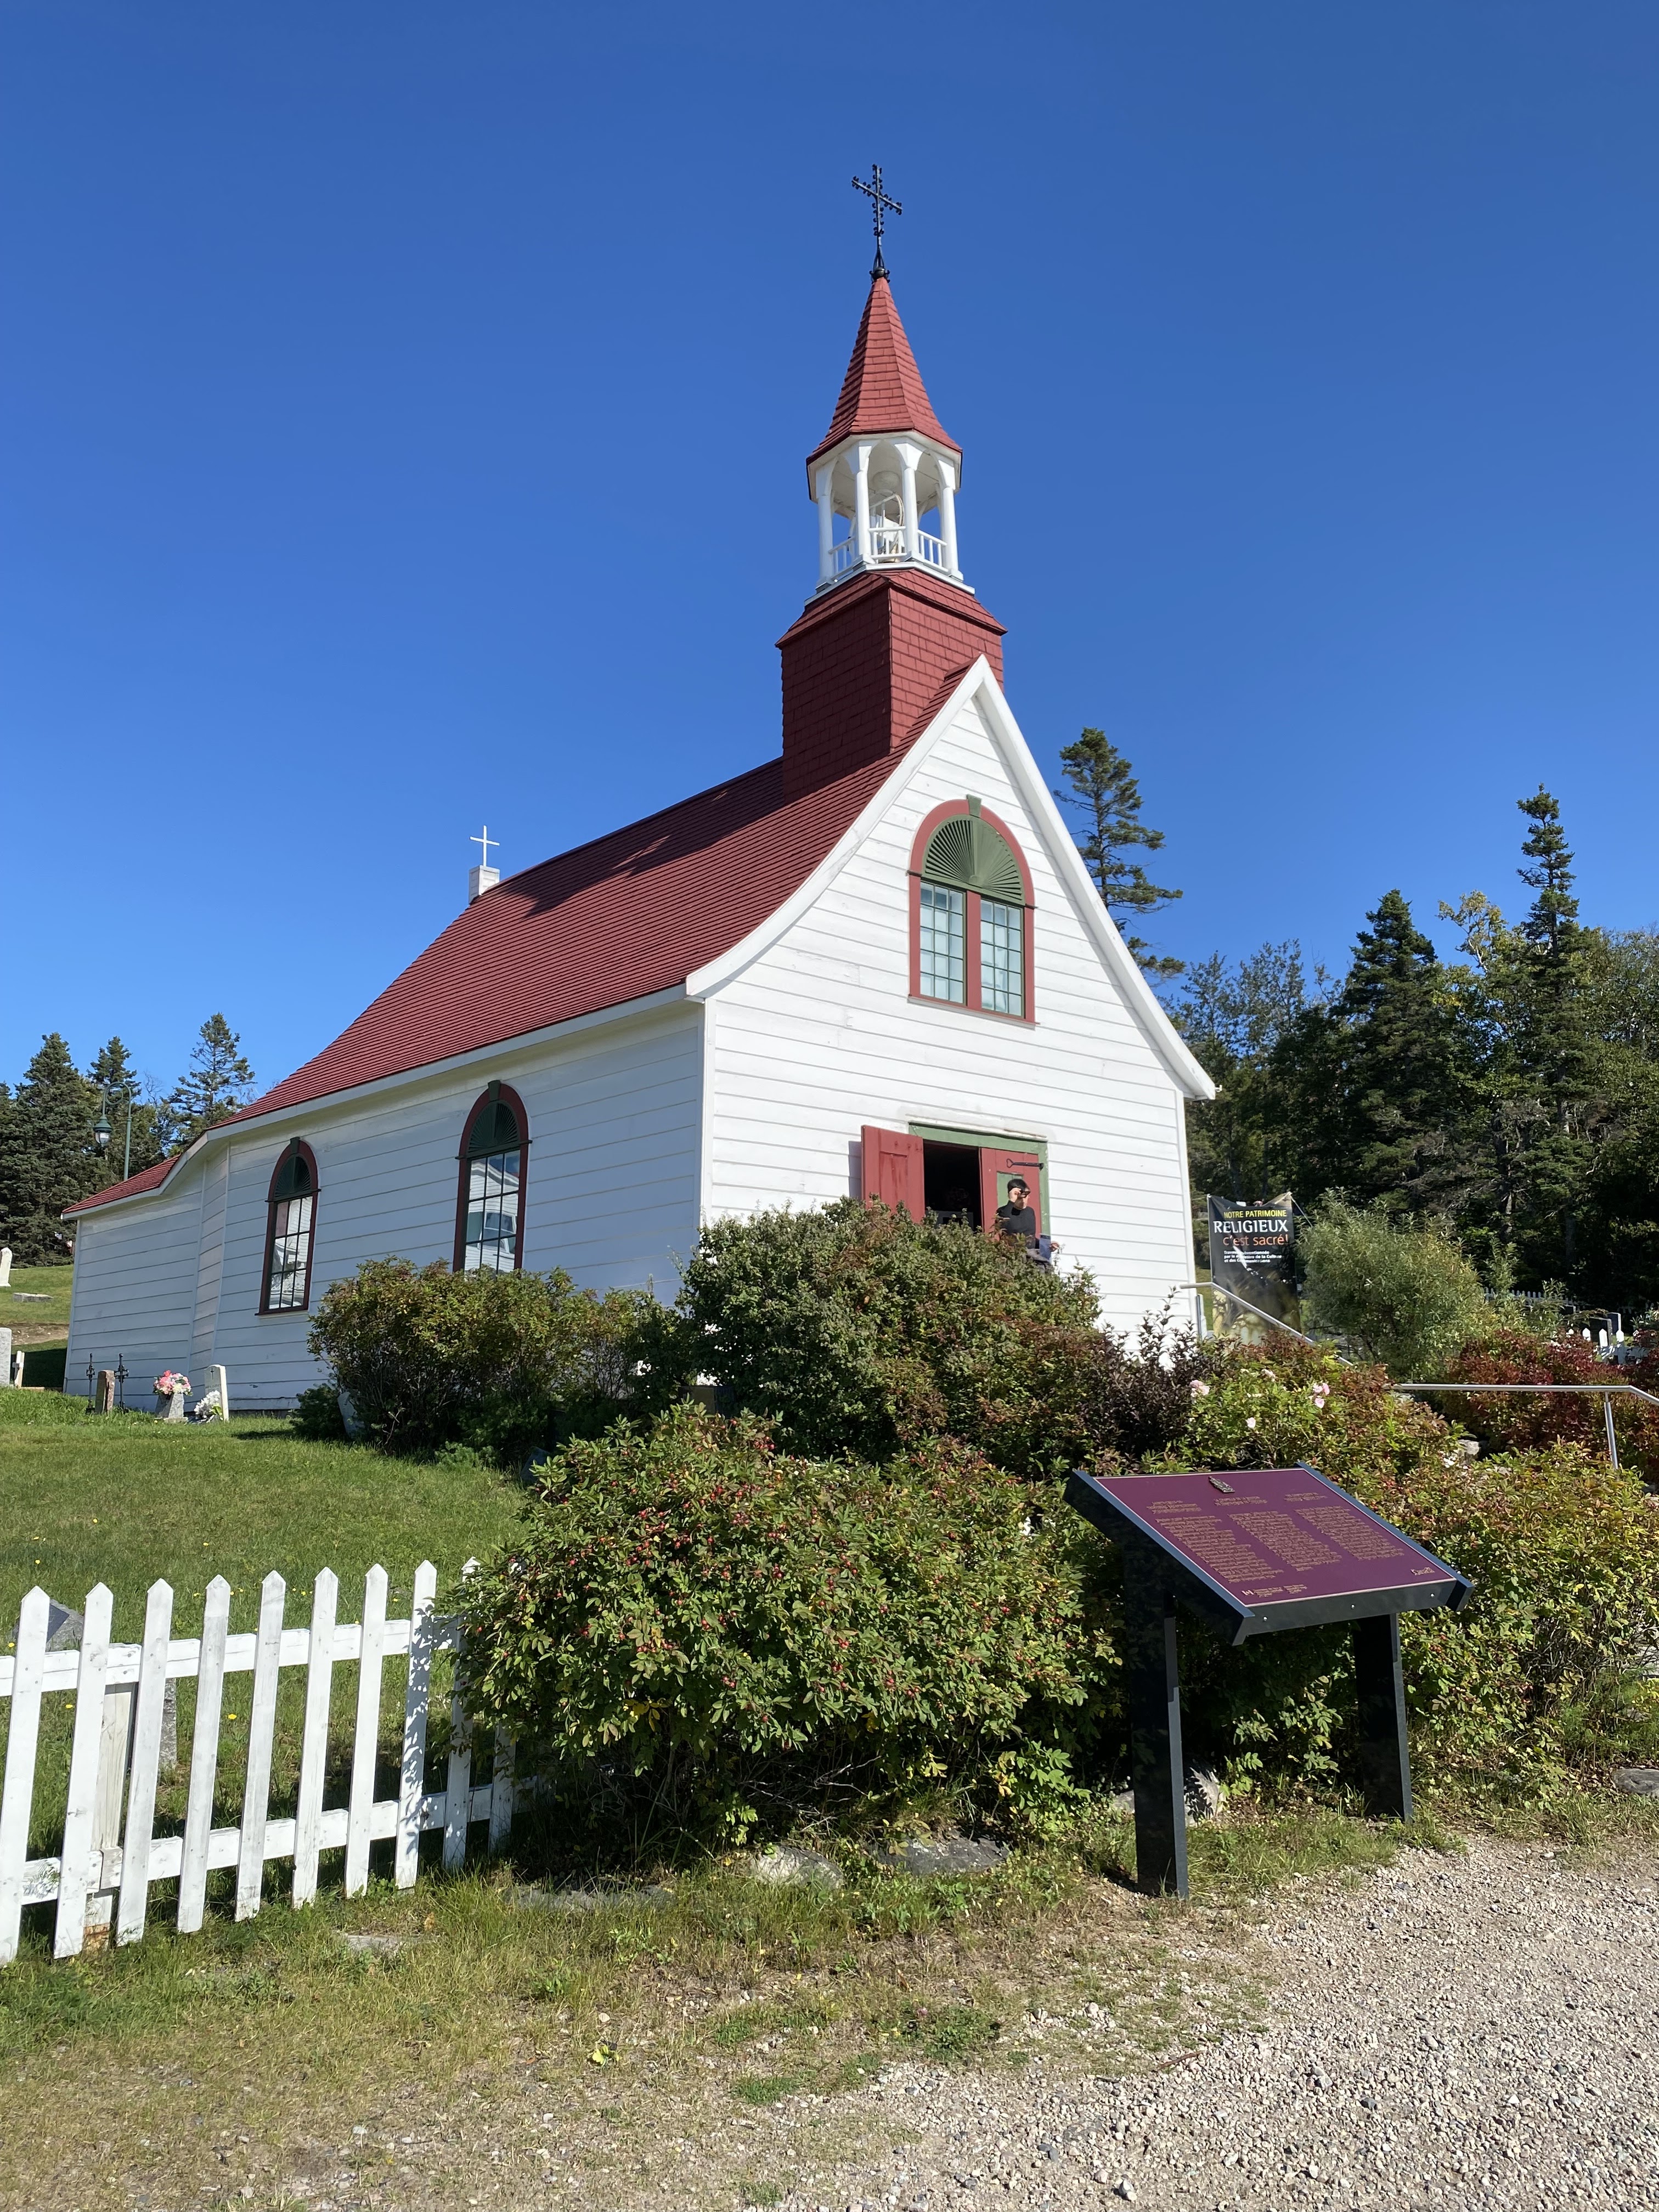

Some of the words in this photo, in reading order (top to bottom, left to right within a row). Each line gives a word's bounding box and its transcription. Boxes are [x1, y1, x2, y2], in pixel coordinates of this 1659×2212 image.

[1213, 1219, 1289, 1233] RELIGIEUX
[1223, 1235, 1249, 1246] c'est
[1253, 1234, 1289, 1246] sacré!
